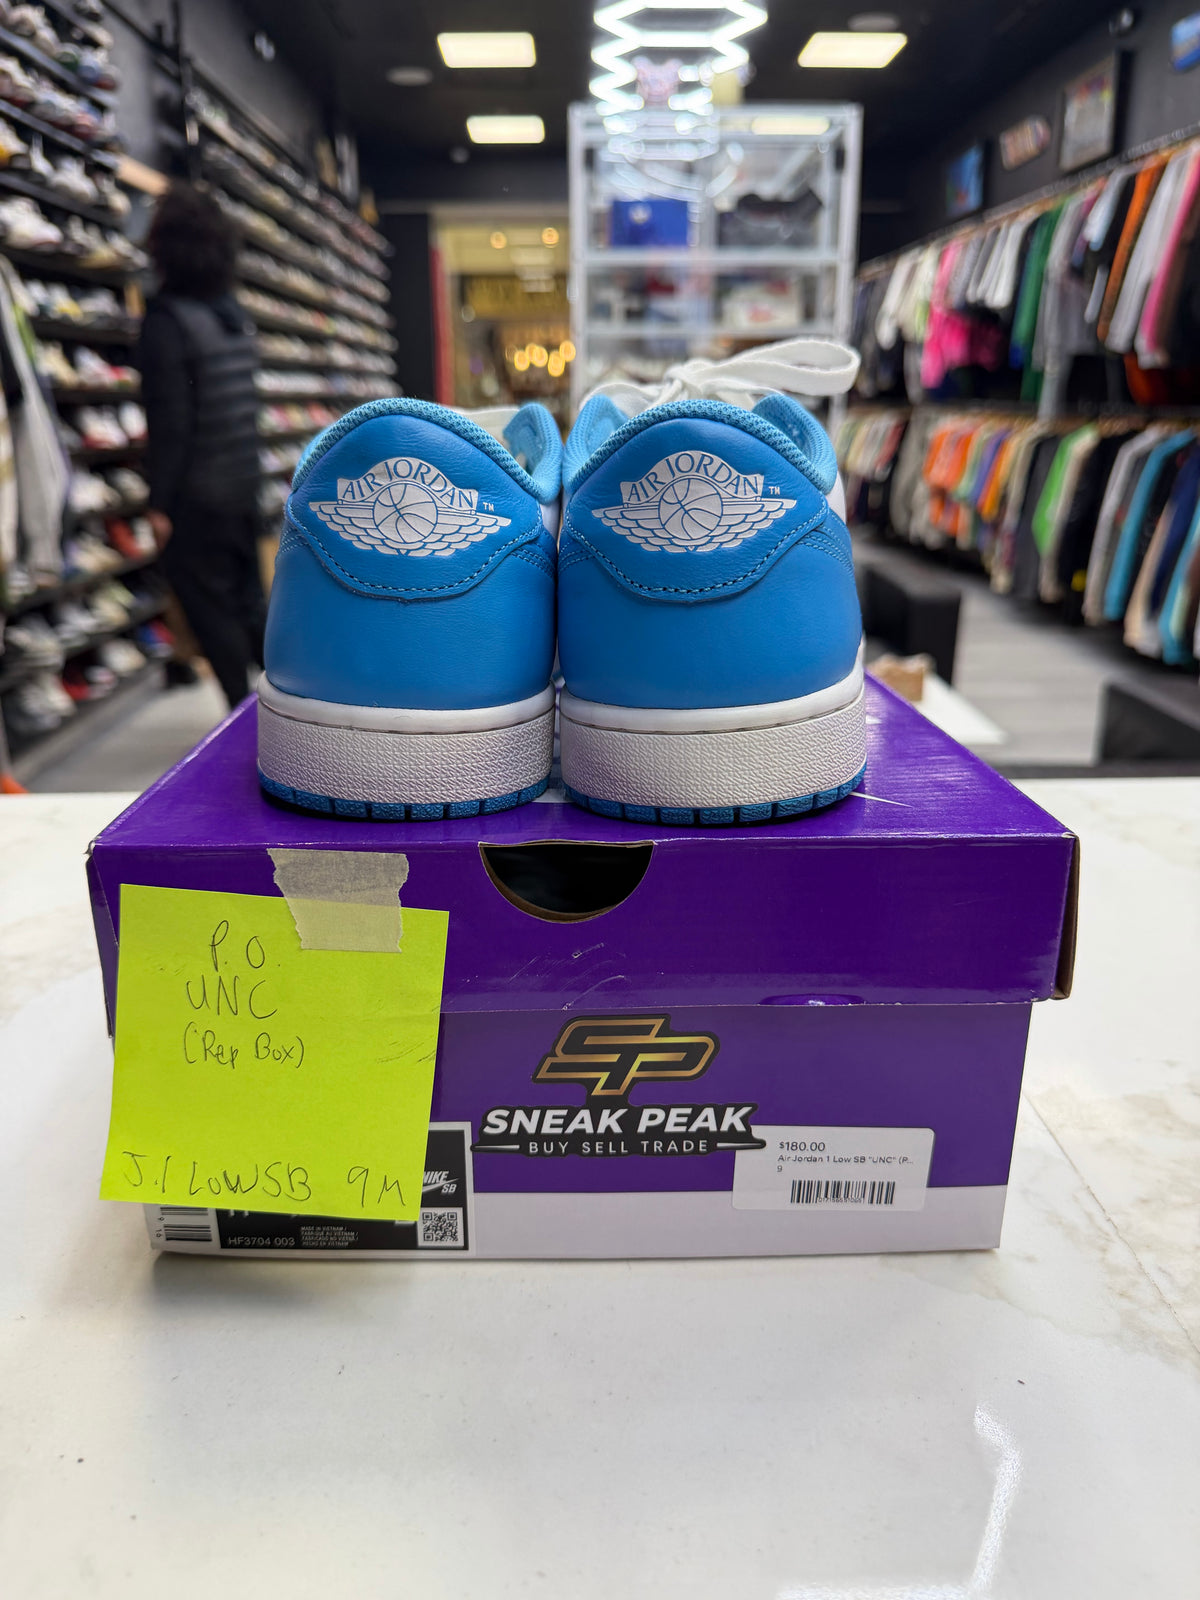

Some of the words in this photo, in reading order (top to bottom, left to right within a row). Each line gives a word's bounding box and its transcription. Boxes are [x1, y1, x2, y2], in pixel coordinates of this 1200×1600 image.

[627, 471, 666, 501] AIR
[665, 453, 759, 496] JORDAN
[342, 473, 382, 500] AIR
[384, 459, 474, 510] JORDAN
[768, 486, 780, 495] TM
[483, 502, 495, 511] TM
[186, 974, 277, 1019] UNC
[255, 1032, 304, 1068] Box)
[483, 1109, 628, 1134] SNEAK
[637, 1106, 753, 1133] PEAK
[529, 1141, 569, 1153] BUY
[582, 1141, 628, 1153] SELL
[641, 1140, 708, 1153] TRADE
[779, 1141, 826, 1152] $180.00
[792, 1155, 823, 1163] Jordan
[777, 1165, 783, 1173] 9
[441, 1183, 457, 1193] SB
[228, 1237, 271, 1246] HF3704
[274, 1237, 296, 1246] 003
